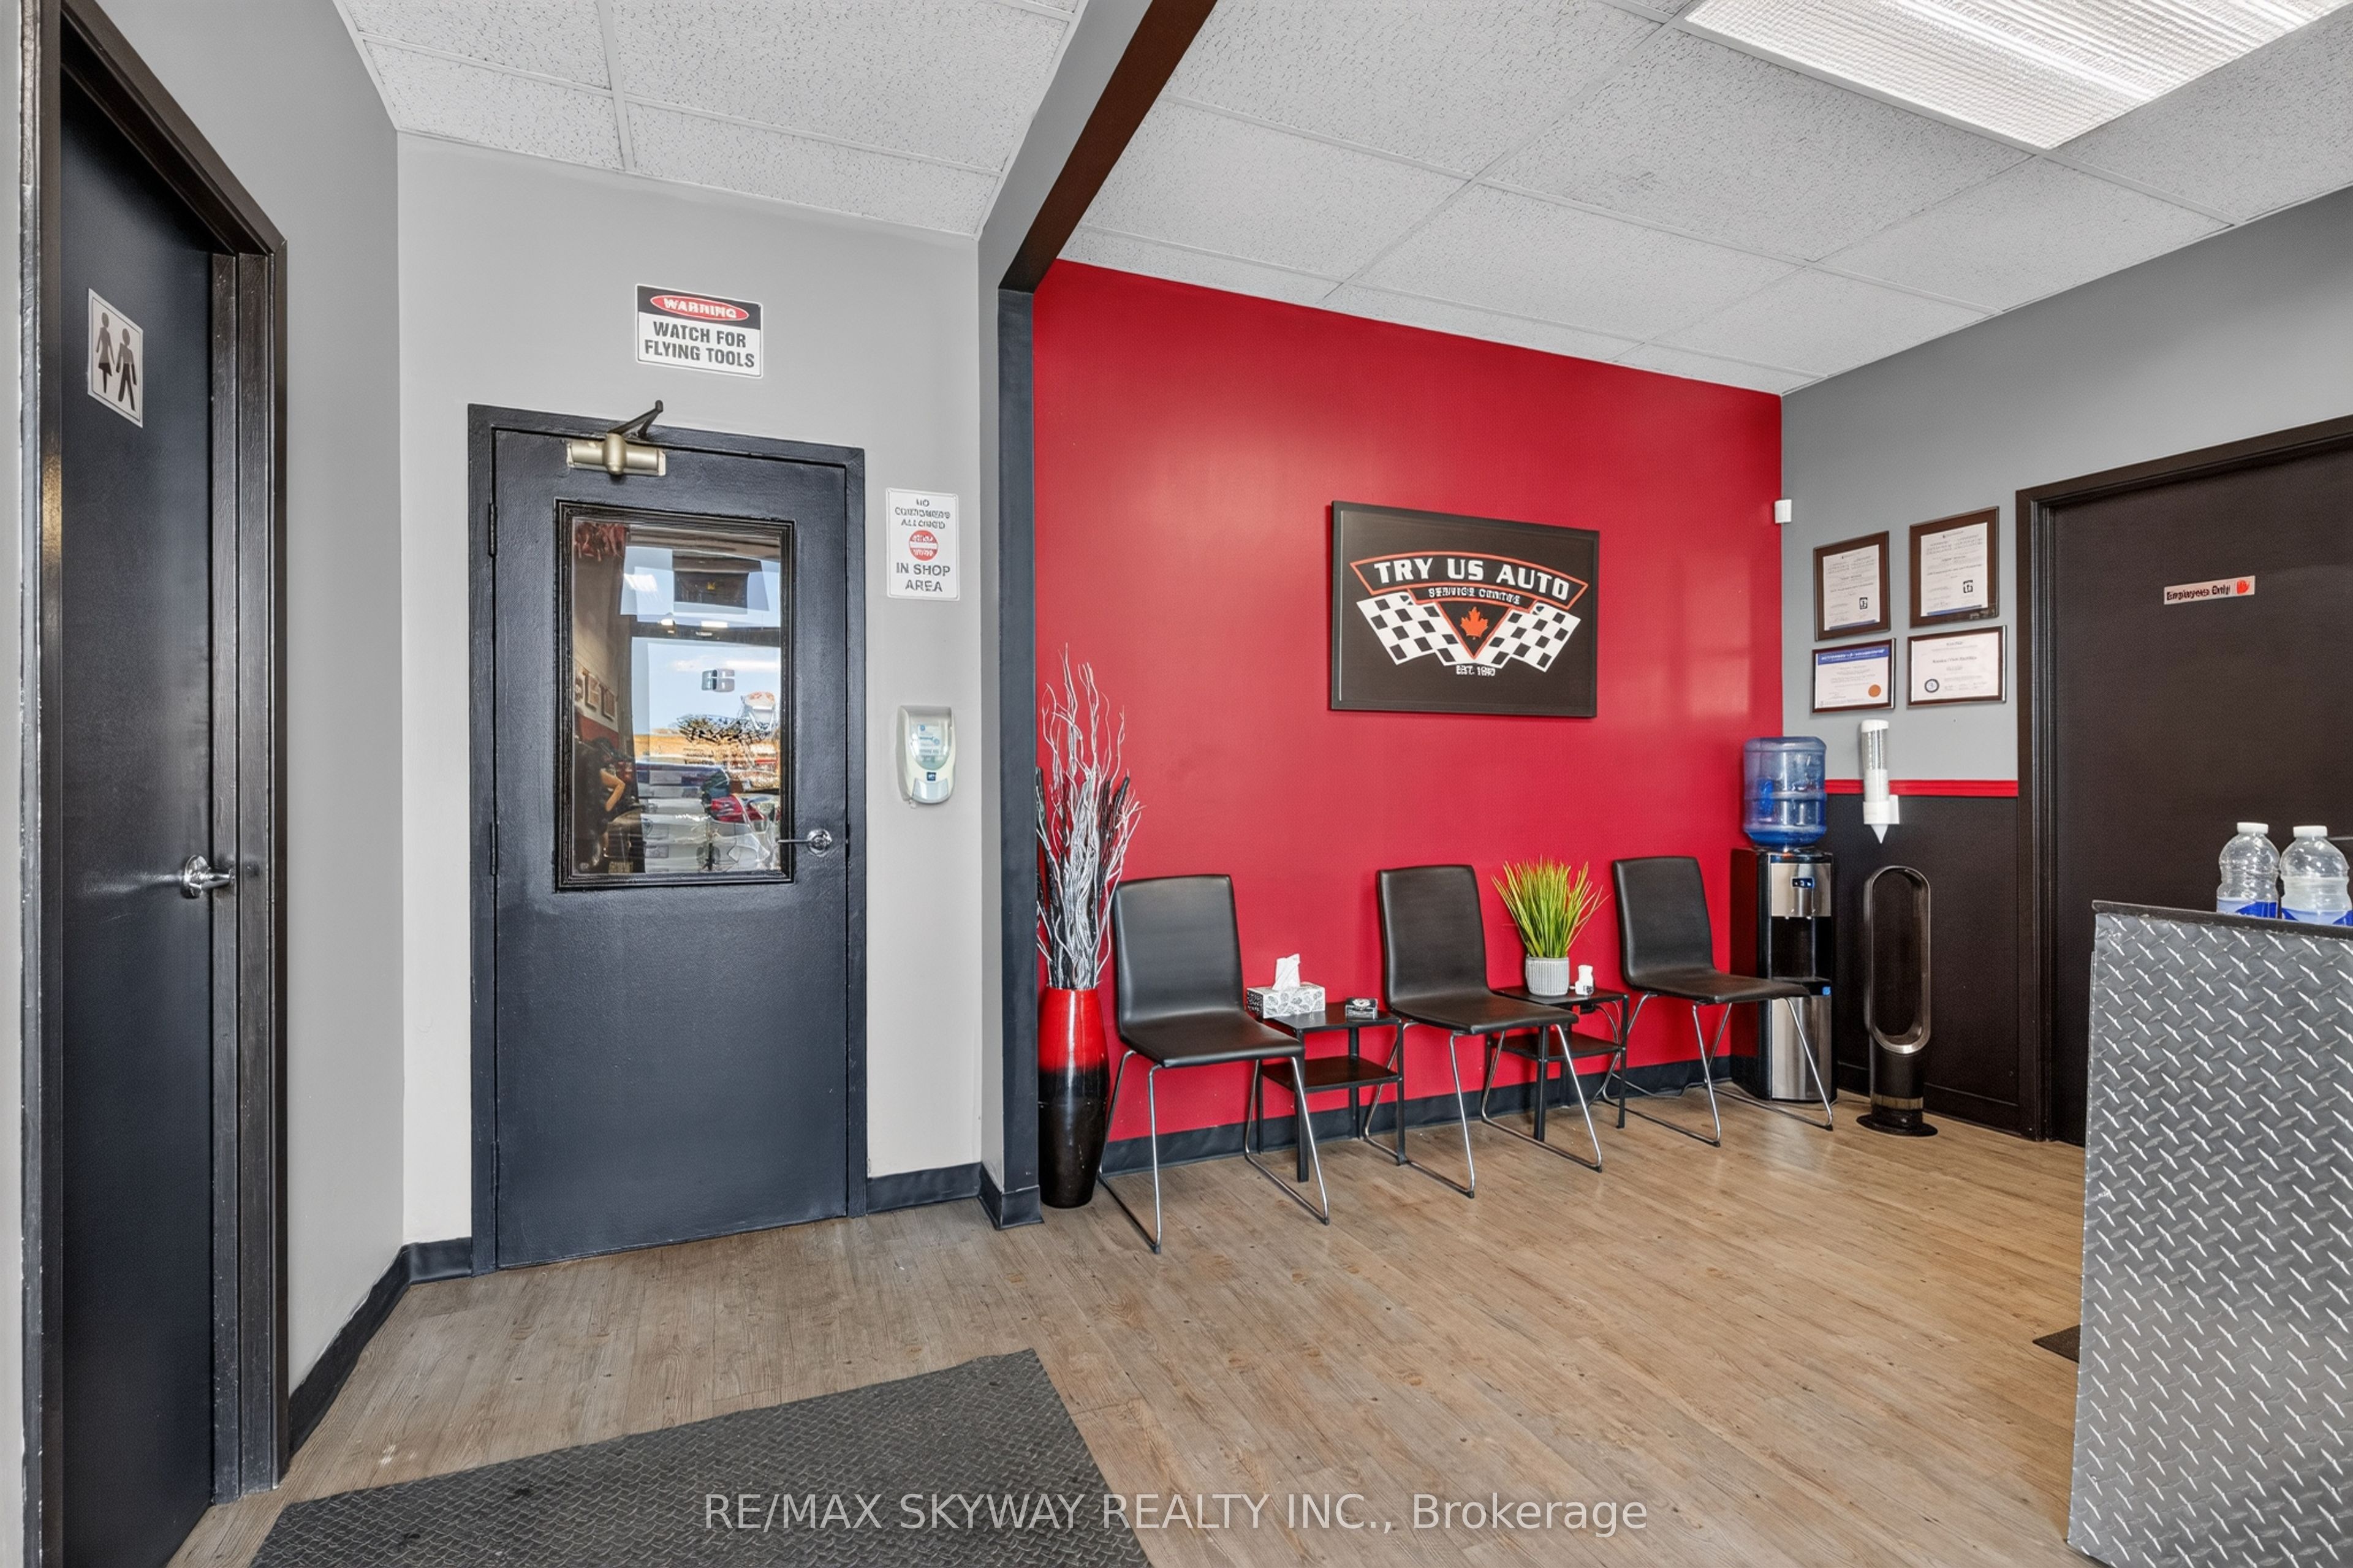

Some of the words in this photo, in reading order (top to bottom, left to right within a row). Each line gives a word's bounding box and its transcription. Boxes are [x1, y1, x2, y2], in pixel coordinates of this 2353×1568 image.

[663, 297, 737, 319] WARNING
[653, 321, 710, 343] WATCH
[716, 330, 746, 348] FOR
[645, 339, 700, 361] FLYING
[705, 347, 755, 368] TOOLS
[895, 507, 950, 519] CUSTOMERS
[901, 519, 945, 529] ALLOWED
[896, 562, 909, 574] IN
[914, 564, 950, 577] SHOP
[905, 579, 943, 593] AREA
[1374, 557, 1433, 583] TRY
[1447, 558, 1484, 581] US
[1496, 564, 1571, 600] AUTO
[1428, 587, 1476, 598] SERVICE
[2166, 588, 2210, 600] Employees
[2211, 584, 2230, 596] Only
[1456, 665, 1475, 675] EST.
